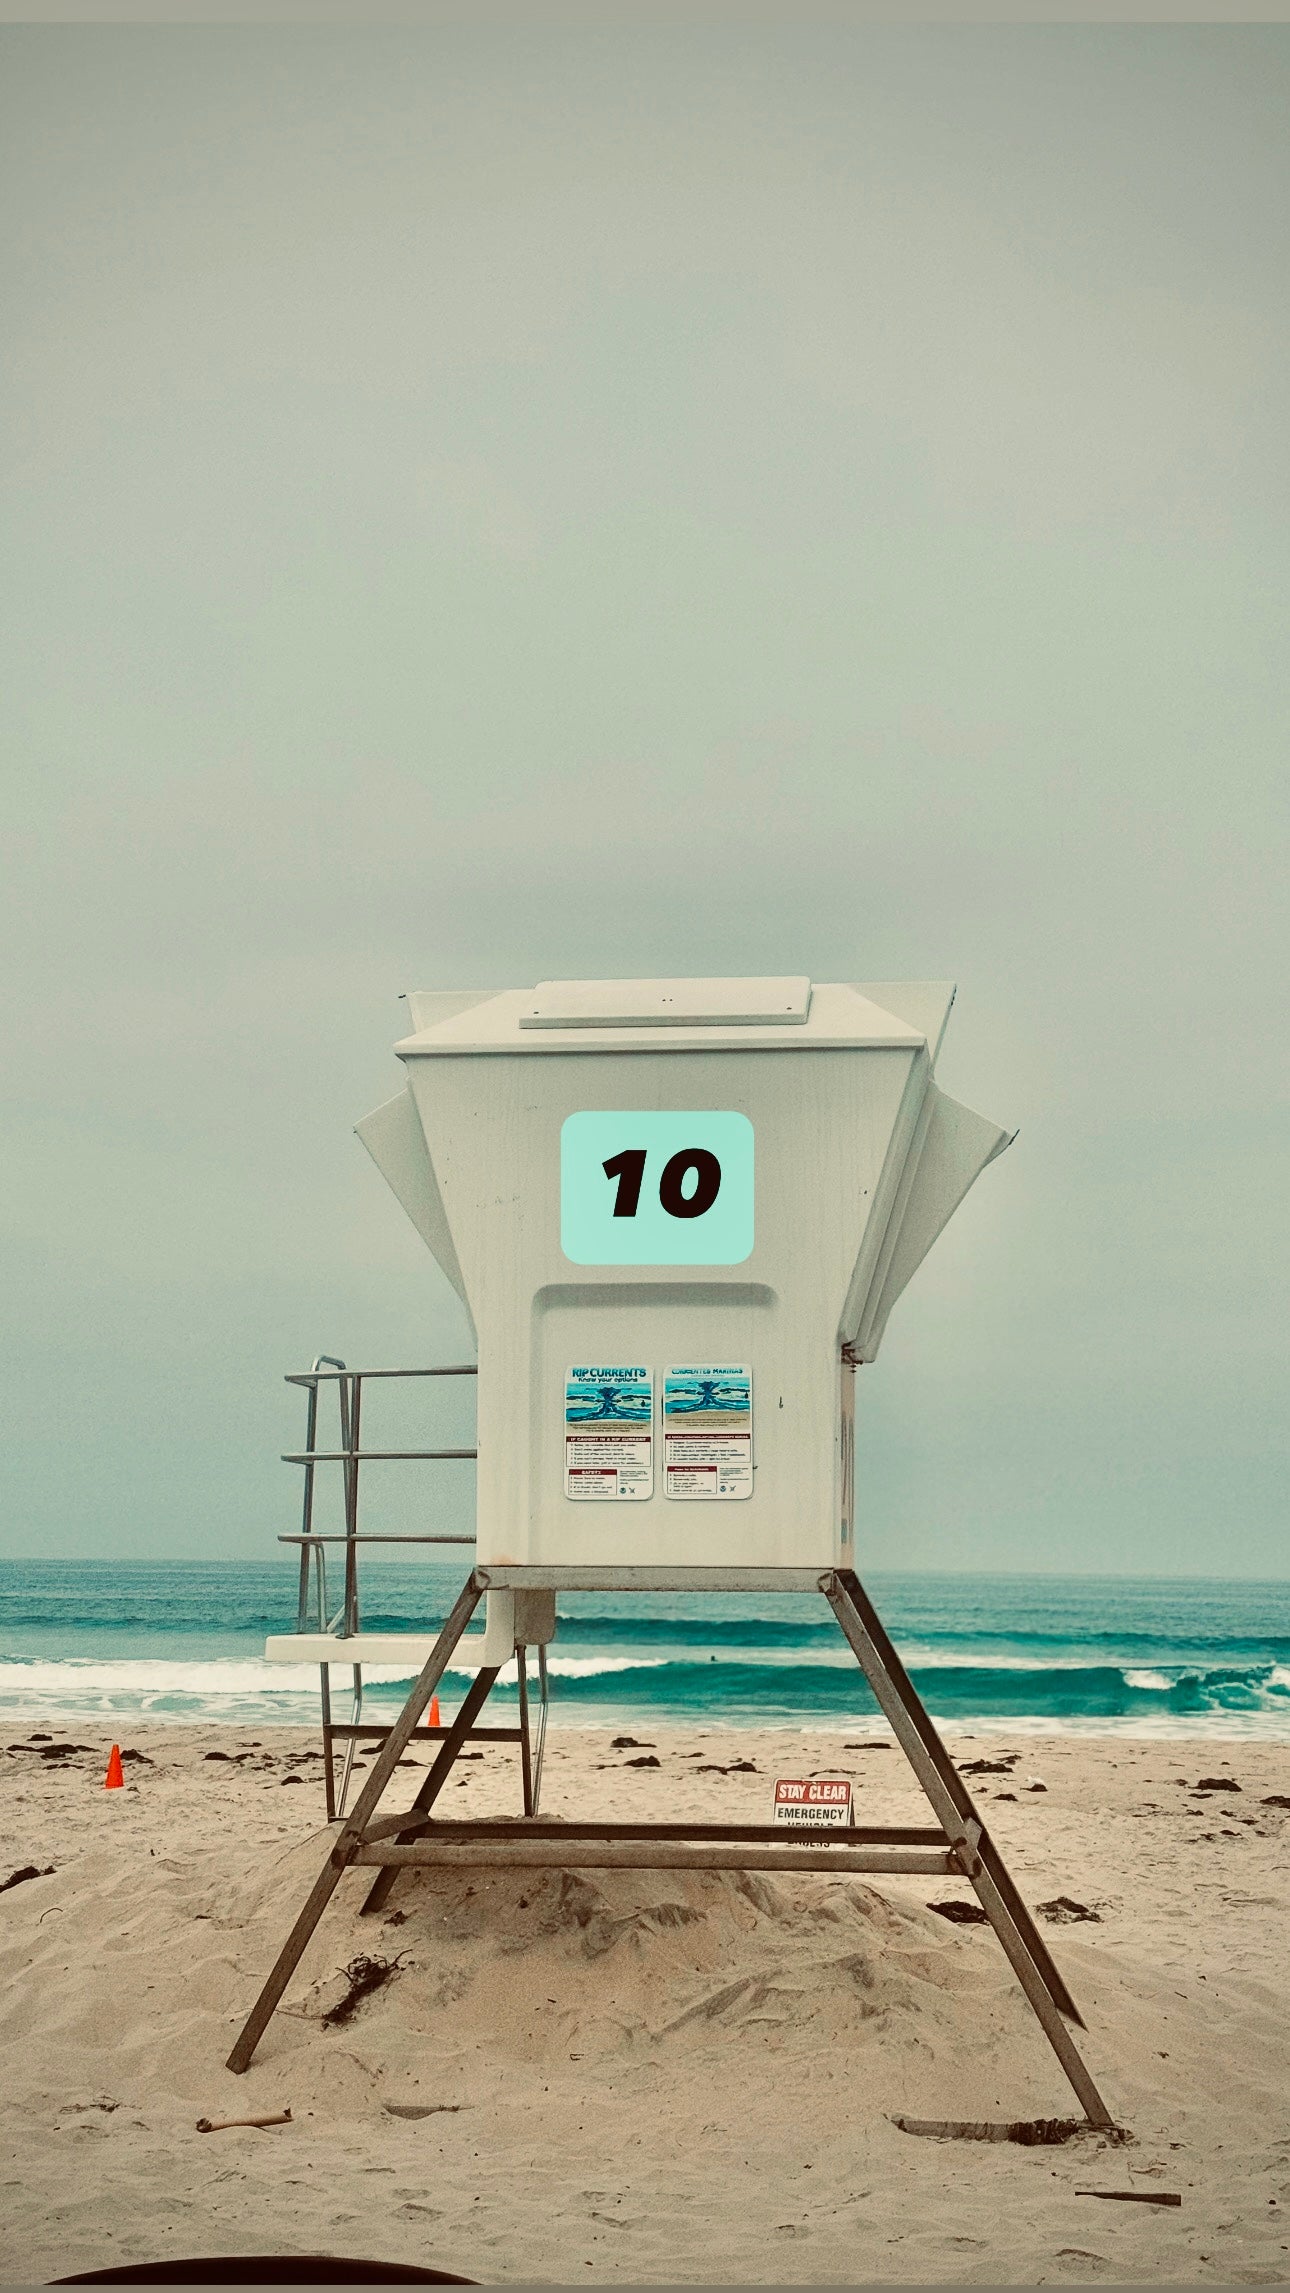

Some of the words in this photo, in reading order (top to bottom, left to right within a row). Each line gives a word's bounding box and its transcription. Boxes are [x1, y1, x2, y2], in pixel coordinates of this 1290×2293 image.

[602, 1148, 722, 1219] 10
[572, 1367, 589, 1378] RIP
[590, 1367, 647, 1378] CURRENTS
[779, 1784, 806, 1799] STAY
[808, 1785, 847, 1801] CLEAR
[777, 1807, 844, 1820] EMERGENCY
